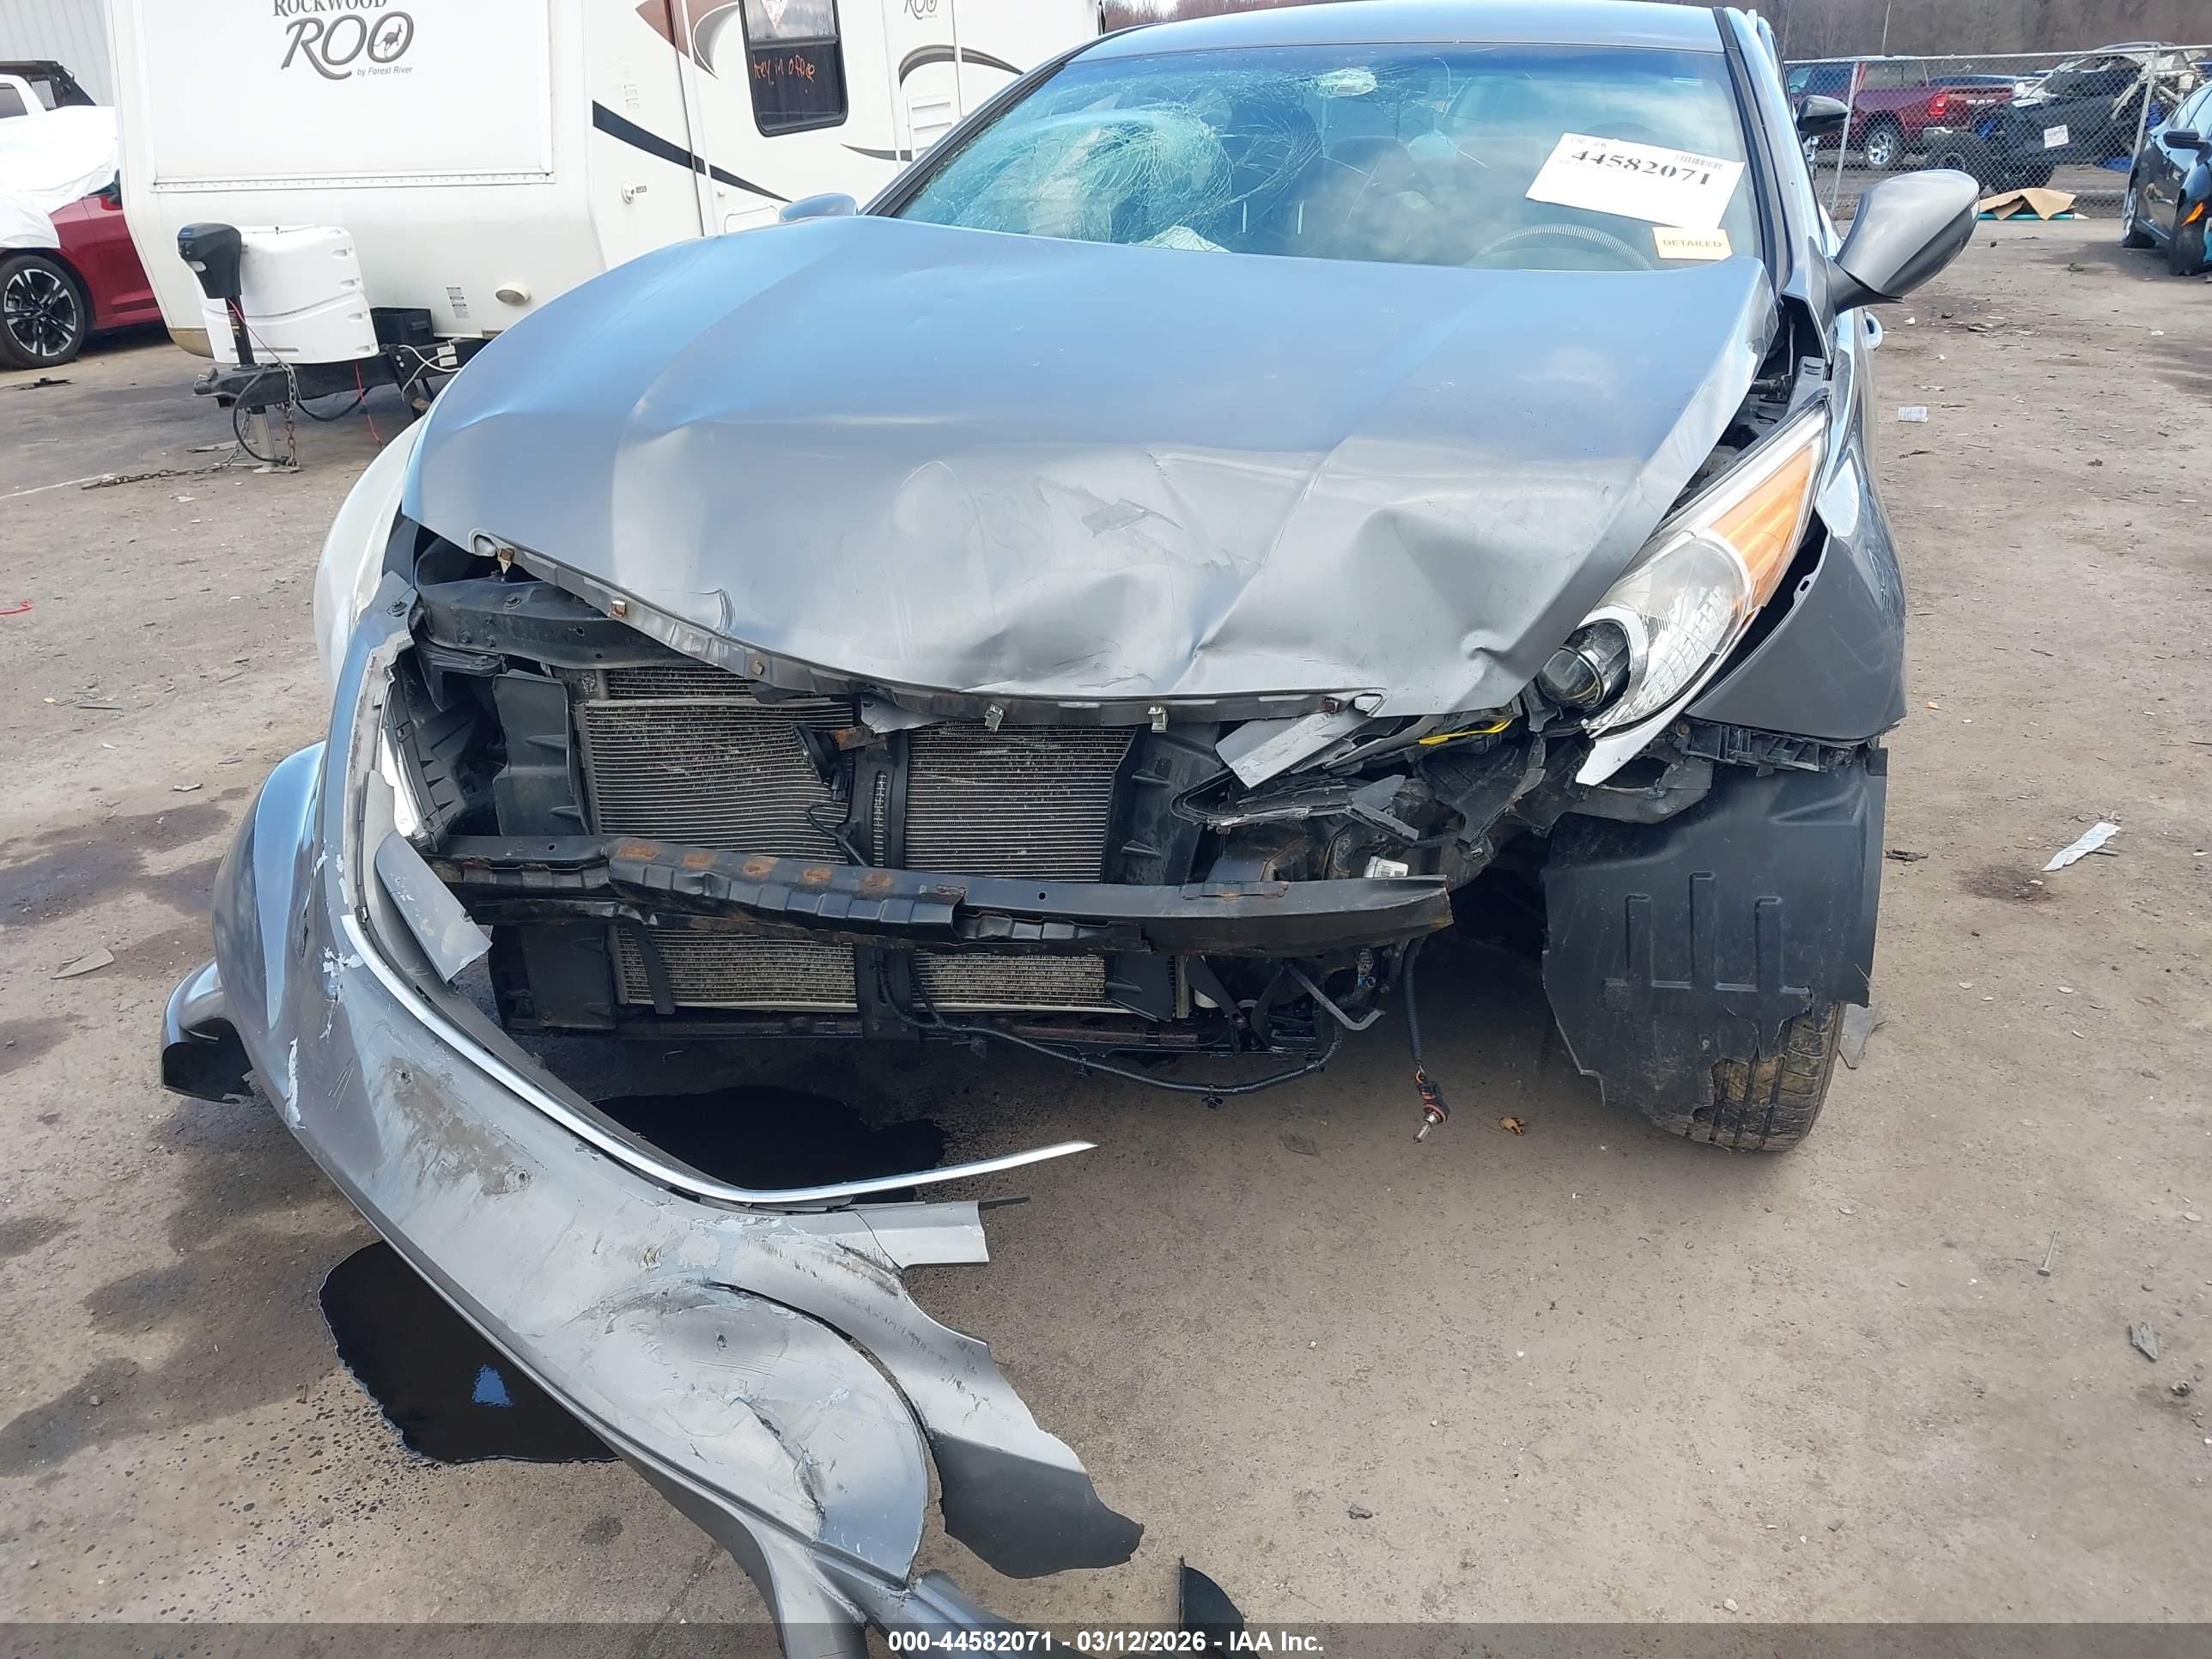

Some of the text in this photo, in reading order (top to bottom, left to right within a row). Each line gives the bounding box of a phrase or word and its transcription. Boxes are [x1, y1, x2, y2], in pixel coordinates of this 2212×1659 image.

[281, 11, 415, 81] ROO
[356, 65, 413, 78] by Forest River
[775, 57, 784, 76] in
[1571, 149, 1711, 185] 44582071
